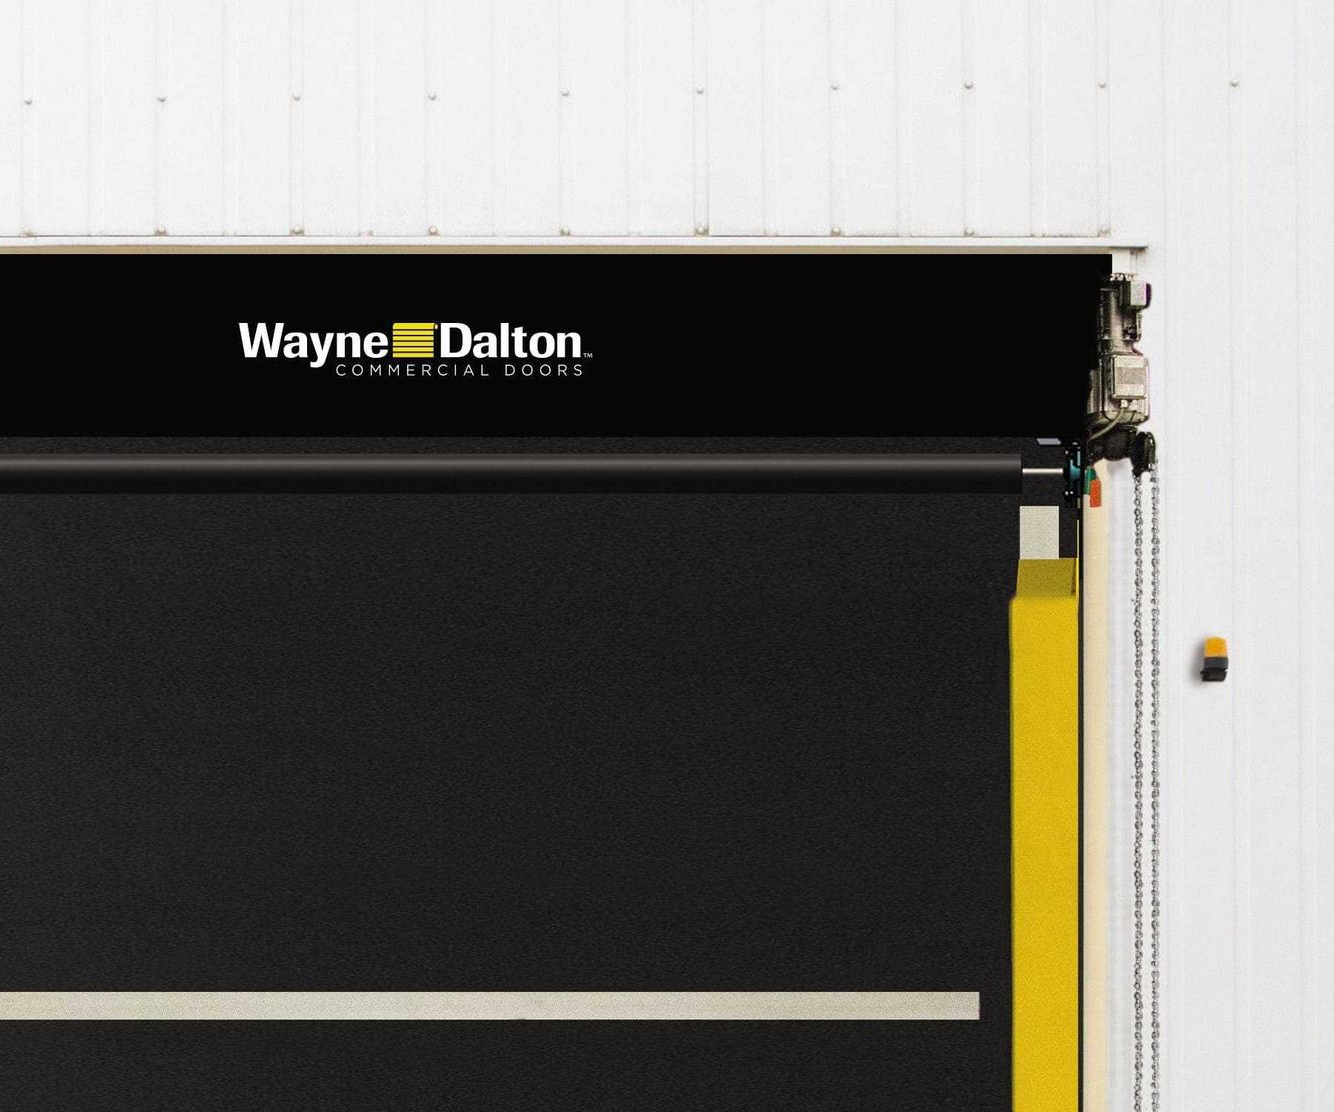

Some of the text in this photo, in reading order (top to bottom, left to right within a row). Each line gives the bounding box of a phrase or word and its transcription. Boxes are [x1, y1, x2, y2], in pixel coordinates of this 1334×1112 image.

[238, 322, 389, 369] Wayne
[335, 363, 583, 377] COMMERCIAL DOORS
